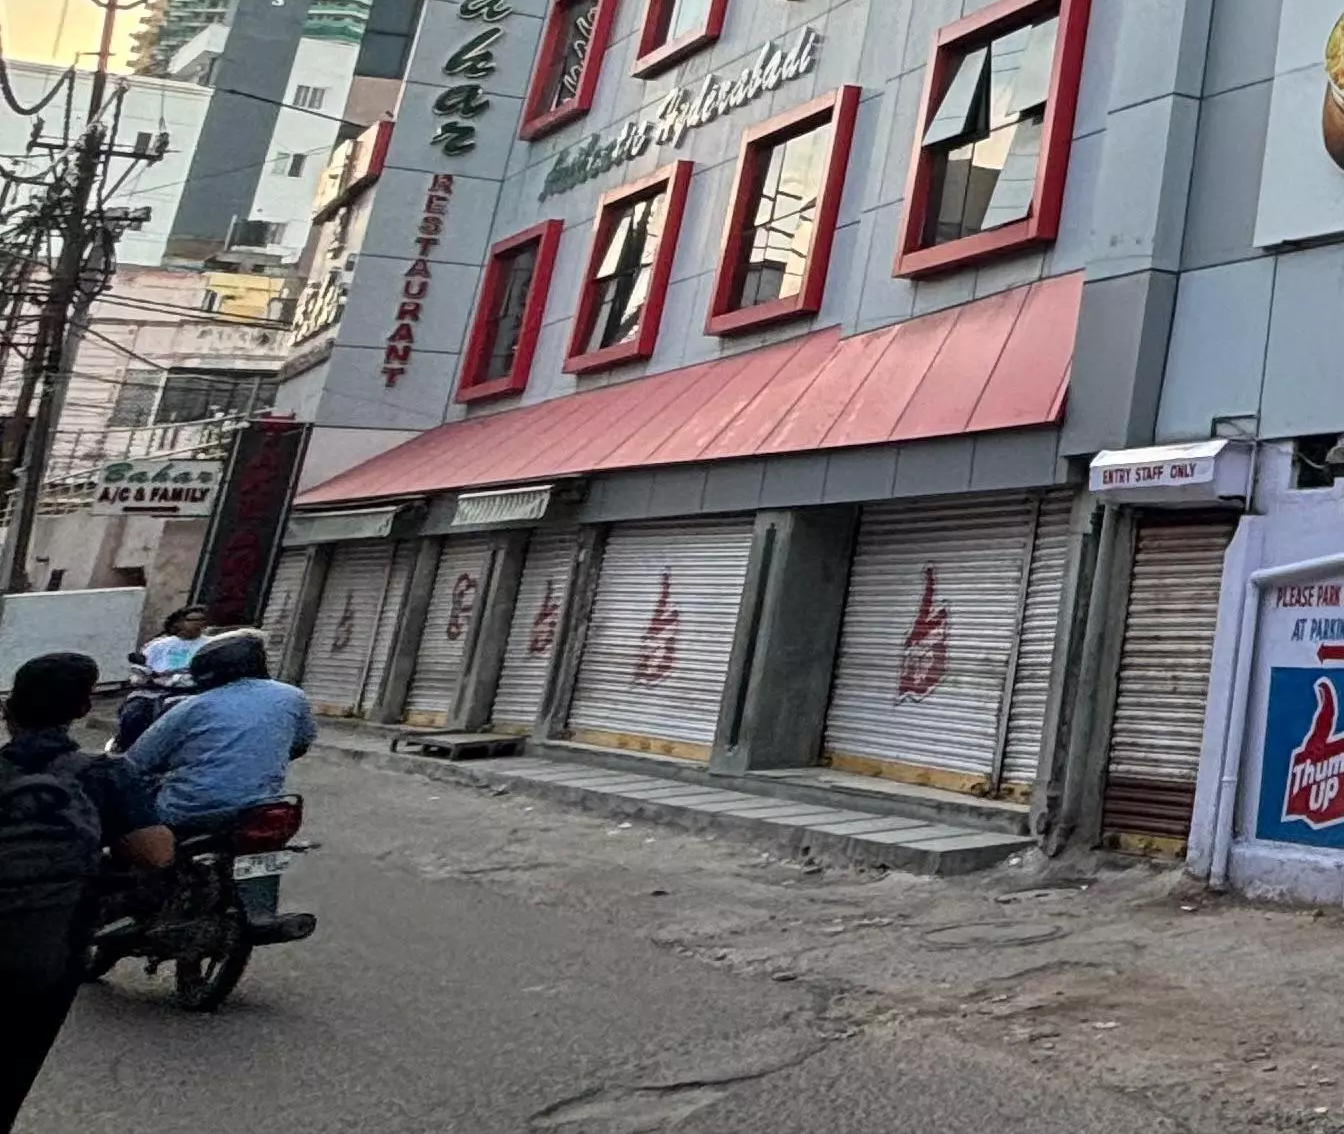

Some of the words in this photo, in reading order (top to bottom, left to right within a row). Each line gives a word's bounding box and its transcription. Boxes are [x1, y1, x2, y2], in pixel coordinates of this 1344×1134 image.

[381, 173, 455, 389] RESTAURANT
[1103, 468, 1132, 485] ENTRY
[1135, 465, 1165, 482] STAFF
[1170, 463, 1197, 479] ONLY
[99, 487, 131, 504] A/C
[150, 487, 212, 504] FAMILY
[1277, 585, 1315, 608] PLEASE
[1316, 583, 1342, 607] PARK
[1290, 618, 1307, 641] AT
[1309, 776, 1340, 812] UP
